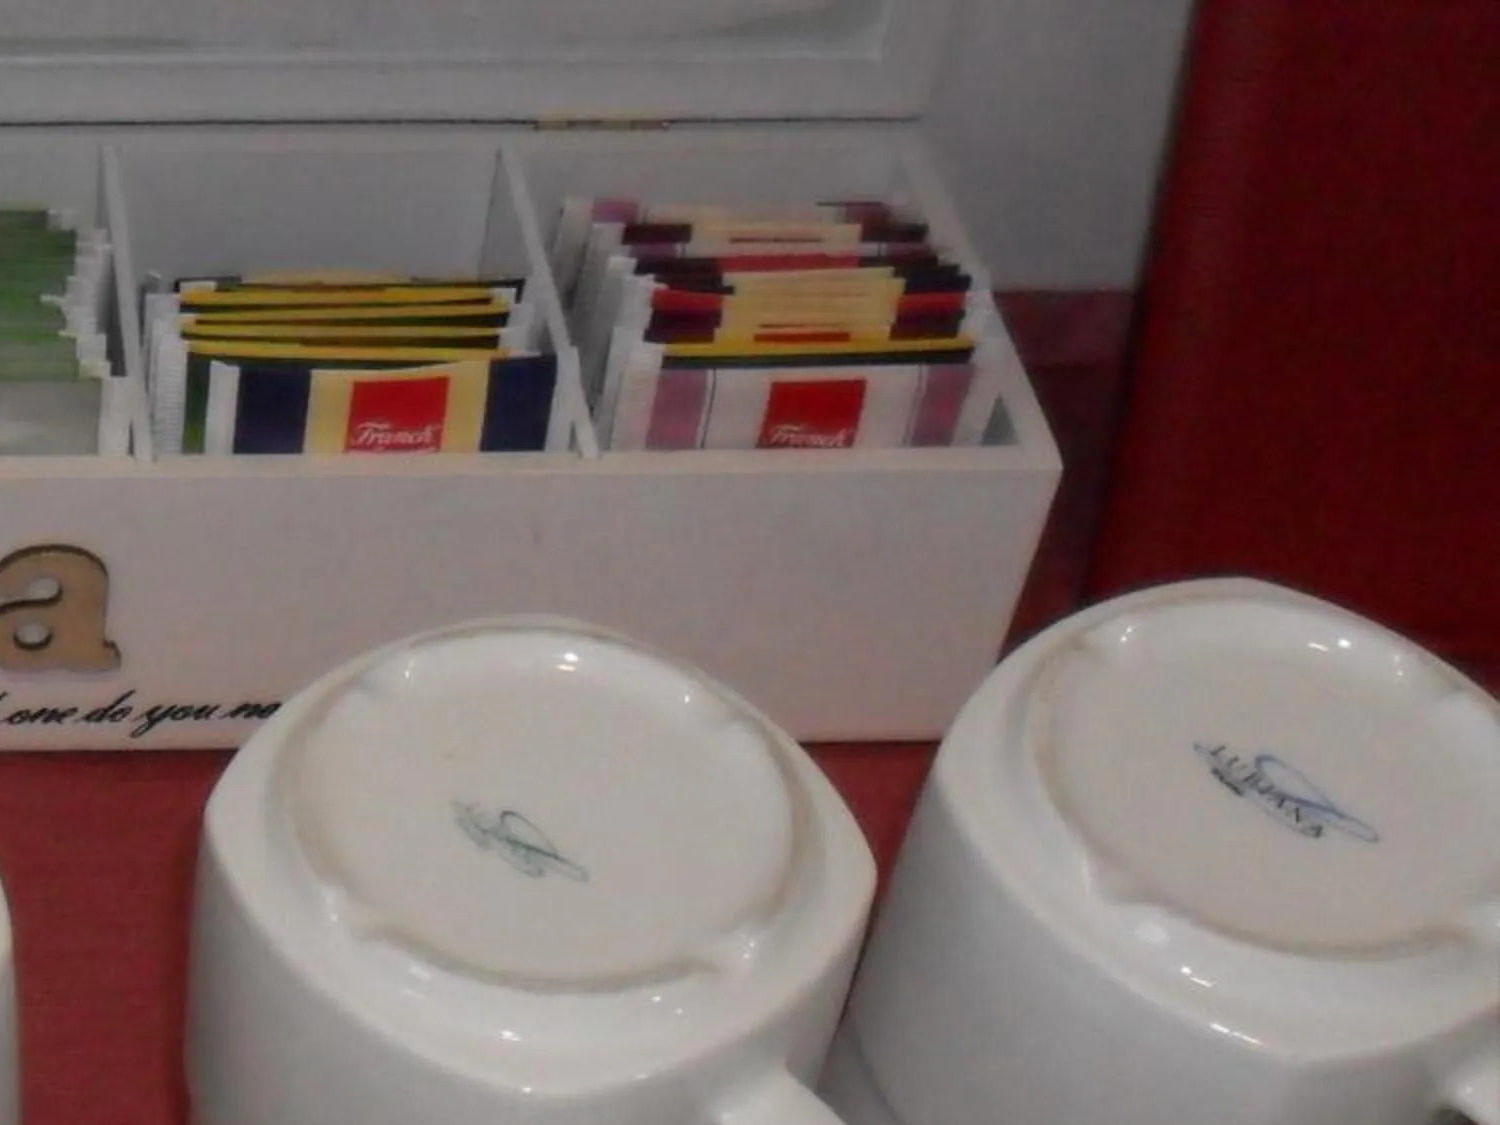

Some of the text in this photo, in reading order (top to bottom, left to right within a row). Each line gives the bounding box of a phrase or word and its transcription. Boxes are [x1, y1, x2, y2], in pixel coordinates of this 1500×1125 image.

[4, 705, 78, 725] one
[78, 689, 136, 723] do
[130, 703, 222, 738] you
